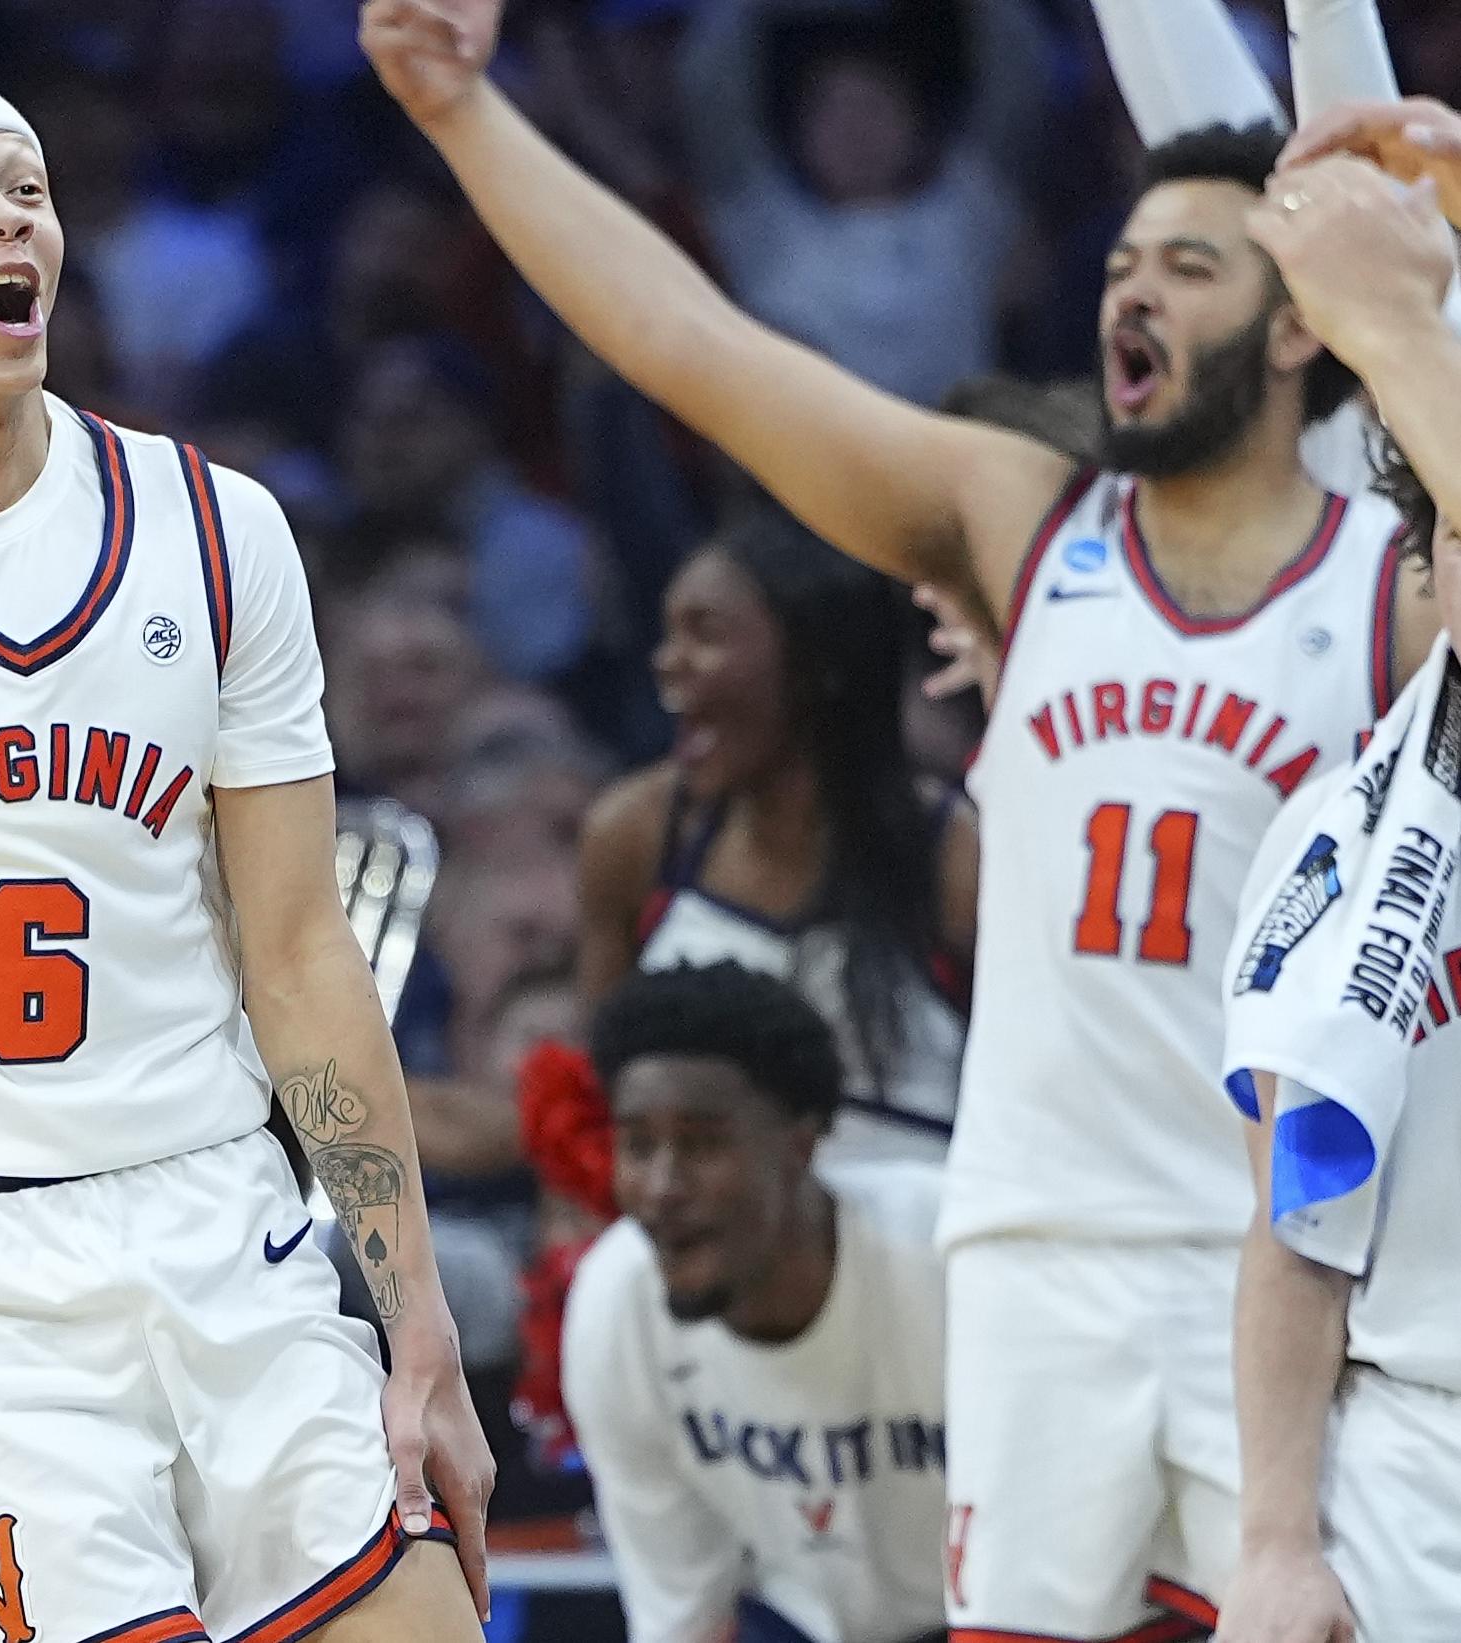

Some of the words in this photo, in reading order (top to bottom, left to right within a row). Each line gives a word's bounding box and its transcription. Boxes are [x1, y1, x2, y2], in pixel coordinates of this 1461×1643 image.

[1027, 679, 1320, 799] VIRGINIA
[1074, 802, 1198, 966] 11
[1374, 826, 1443, 922] FINAL
[1341, 924, 1411, 1022] FOUR
